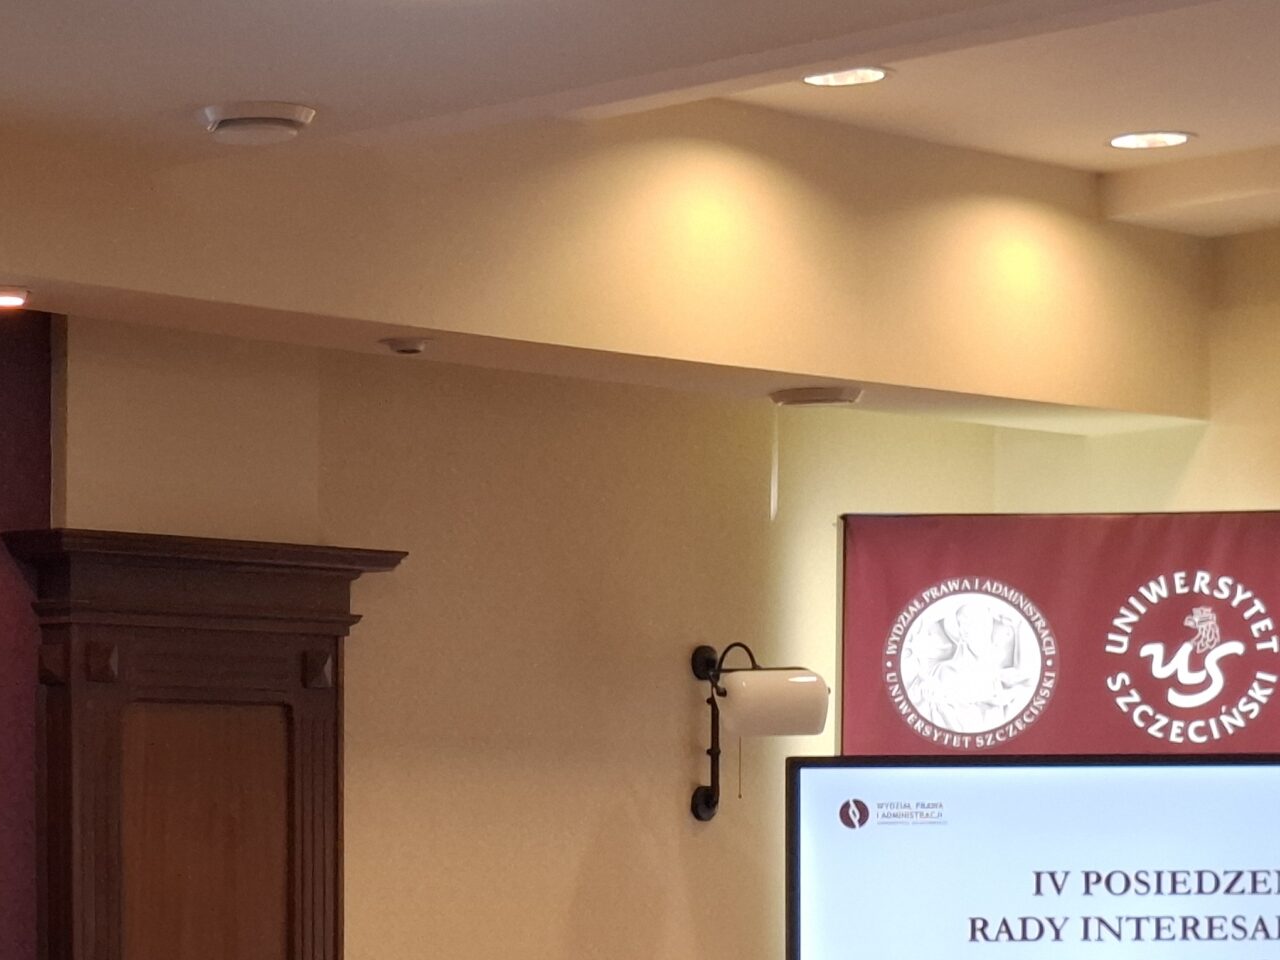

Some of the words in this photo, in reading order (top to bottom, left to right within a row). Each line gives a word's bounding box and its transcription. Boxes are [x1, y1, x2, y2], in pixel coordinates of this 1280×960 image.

[922, 579, 971, 603] PRAWA
[982, 580, 1056, 655] ADMINISTRACJI
[1105, 570, 1280, 655] UNIWERSYTET
[886, 672, 971, 748] UNIWERSYTET
[1106, 671, 1278, 744] SZCZECIŃSKI
[1033, 870, 1071, 896] IV
[969, 916, 1069, 942] RADY
[1082, 915, 1280, 942] INTERESA
